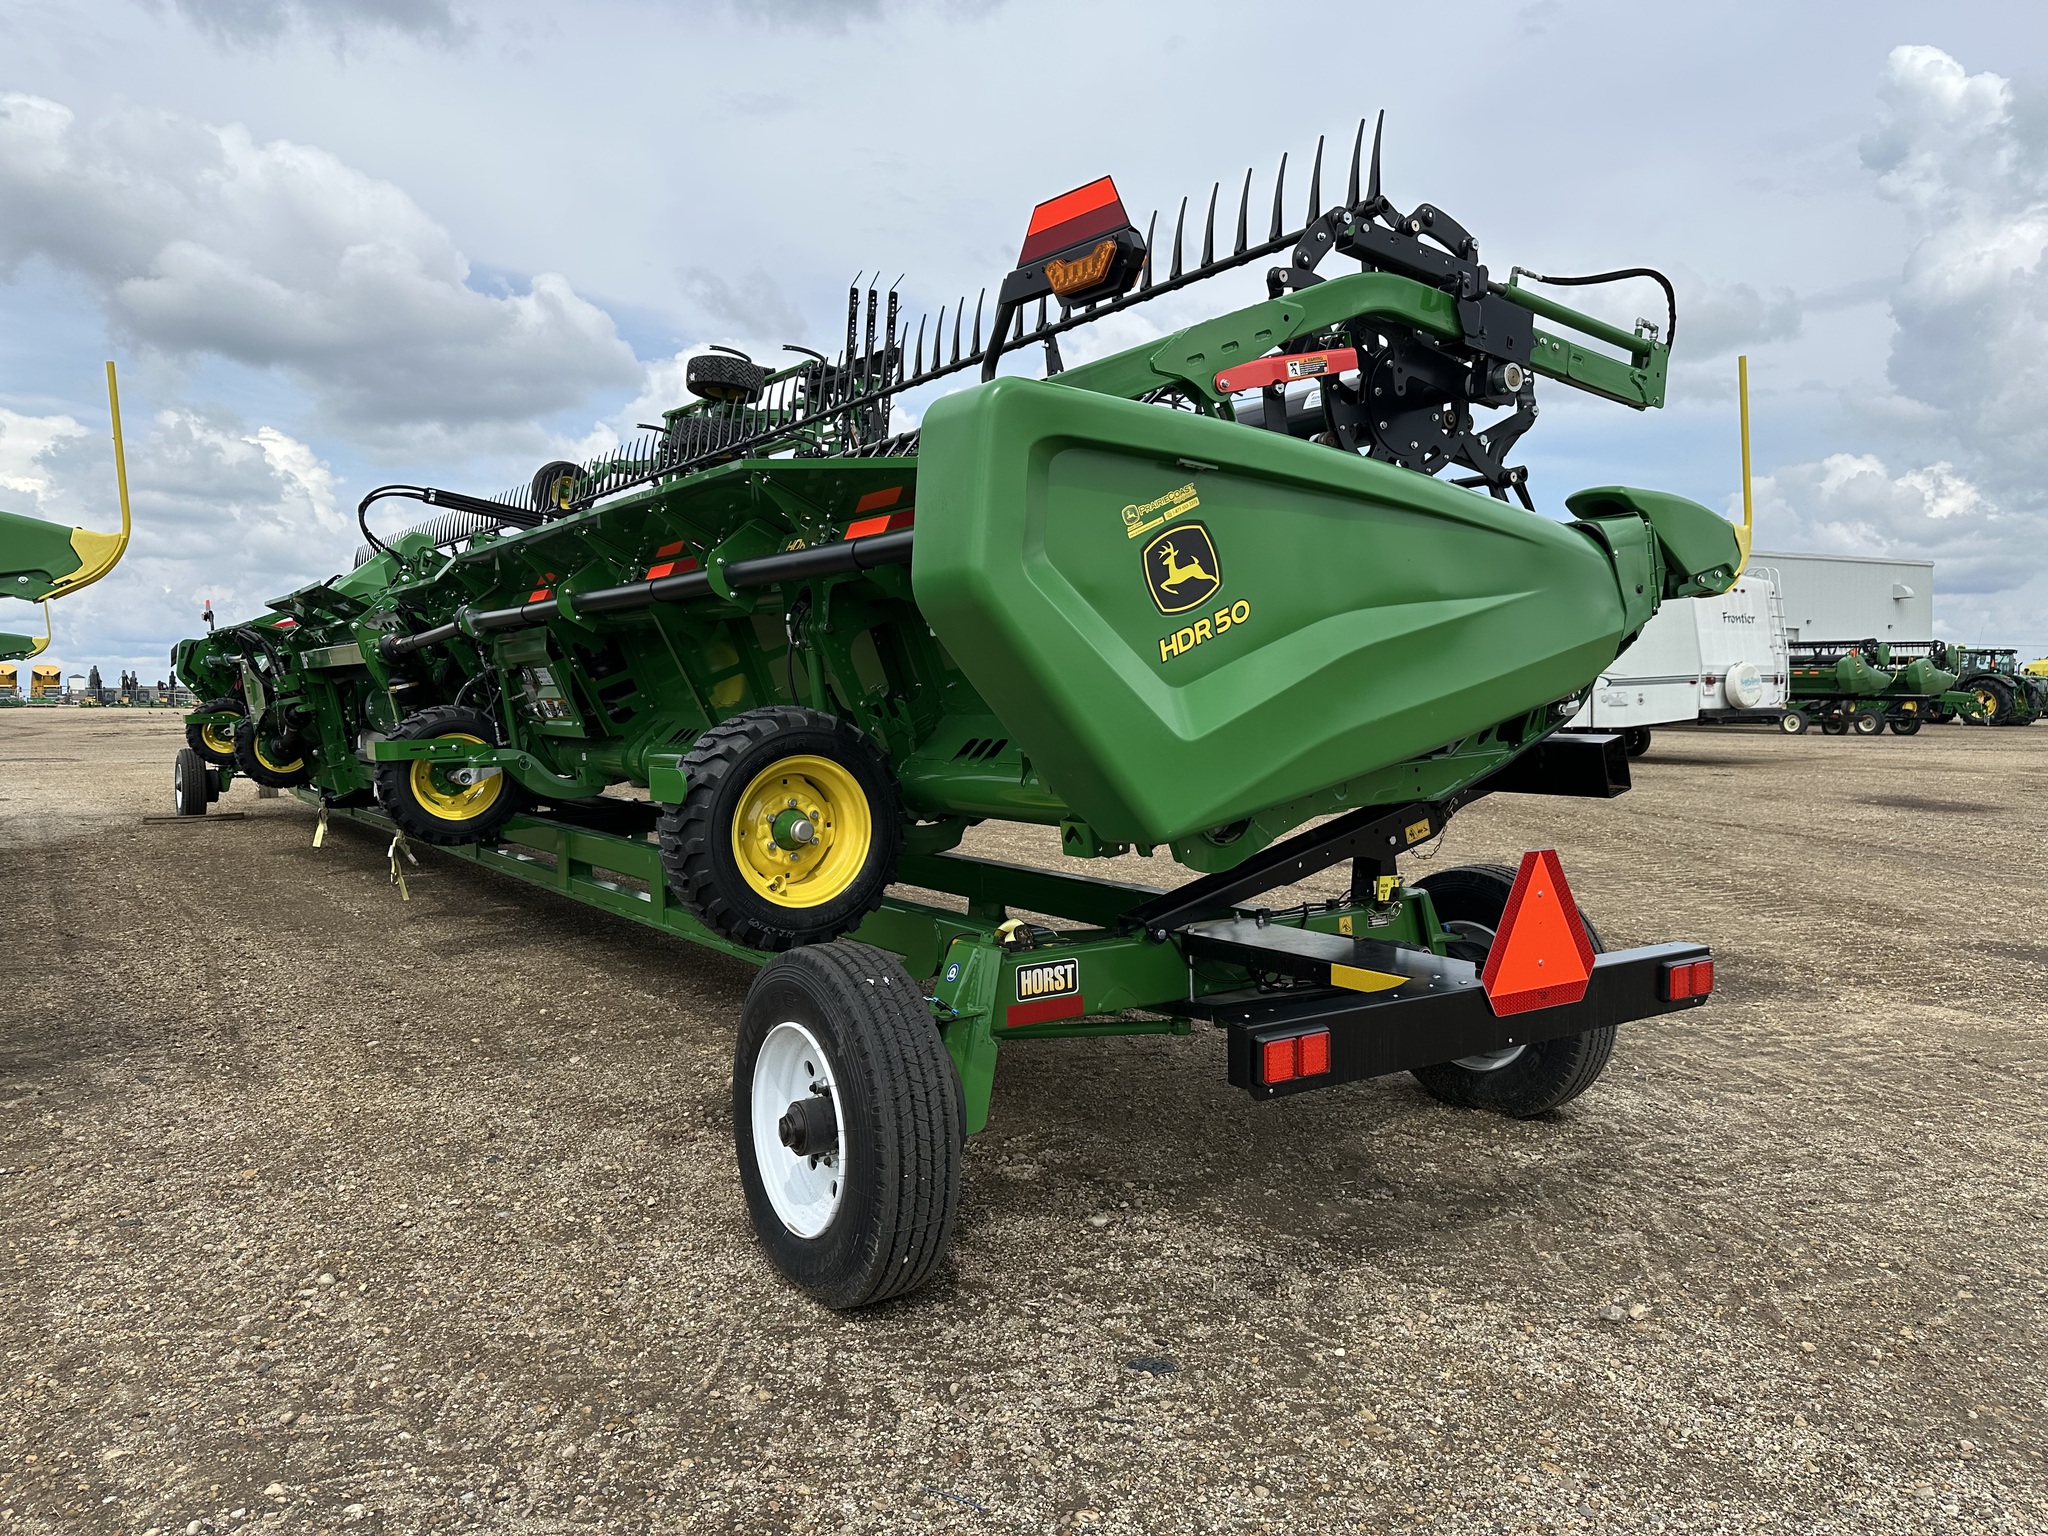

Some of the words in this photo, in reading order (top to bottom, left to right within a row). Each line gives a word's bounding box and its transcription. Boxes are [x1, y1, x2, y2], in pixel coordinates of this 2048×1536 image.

[1159, 617, 1214, 663] HDR
[1213, 598, 1251, 635] 50
[1722, 611, 1756, 624] Frontier
[1020, 963, 1075, 997] HORST
